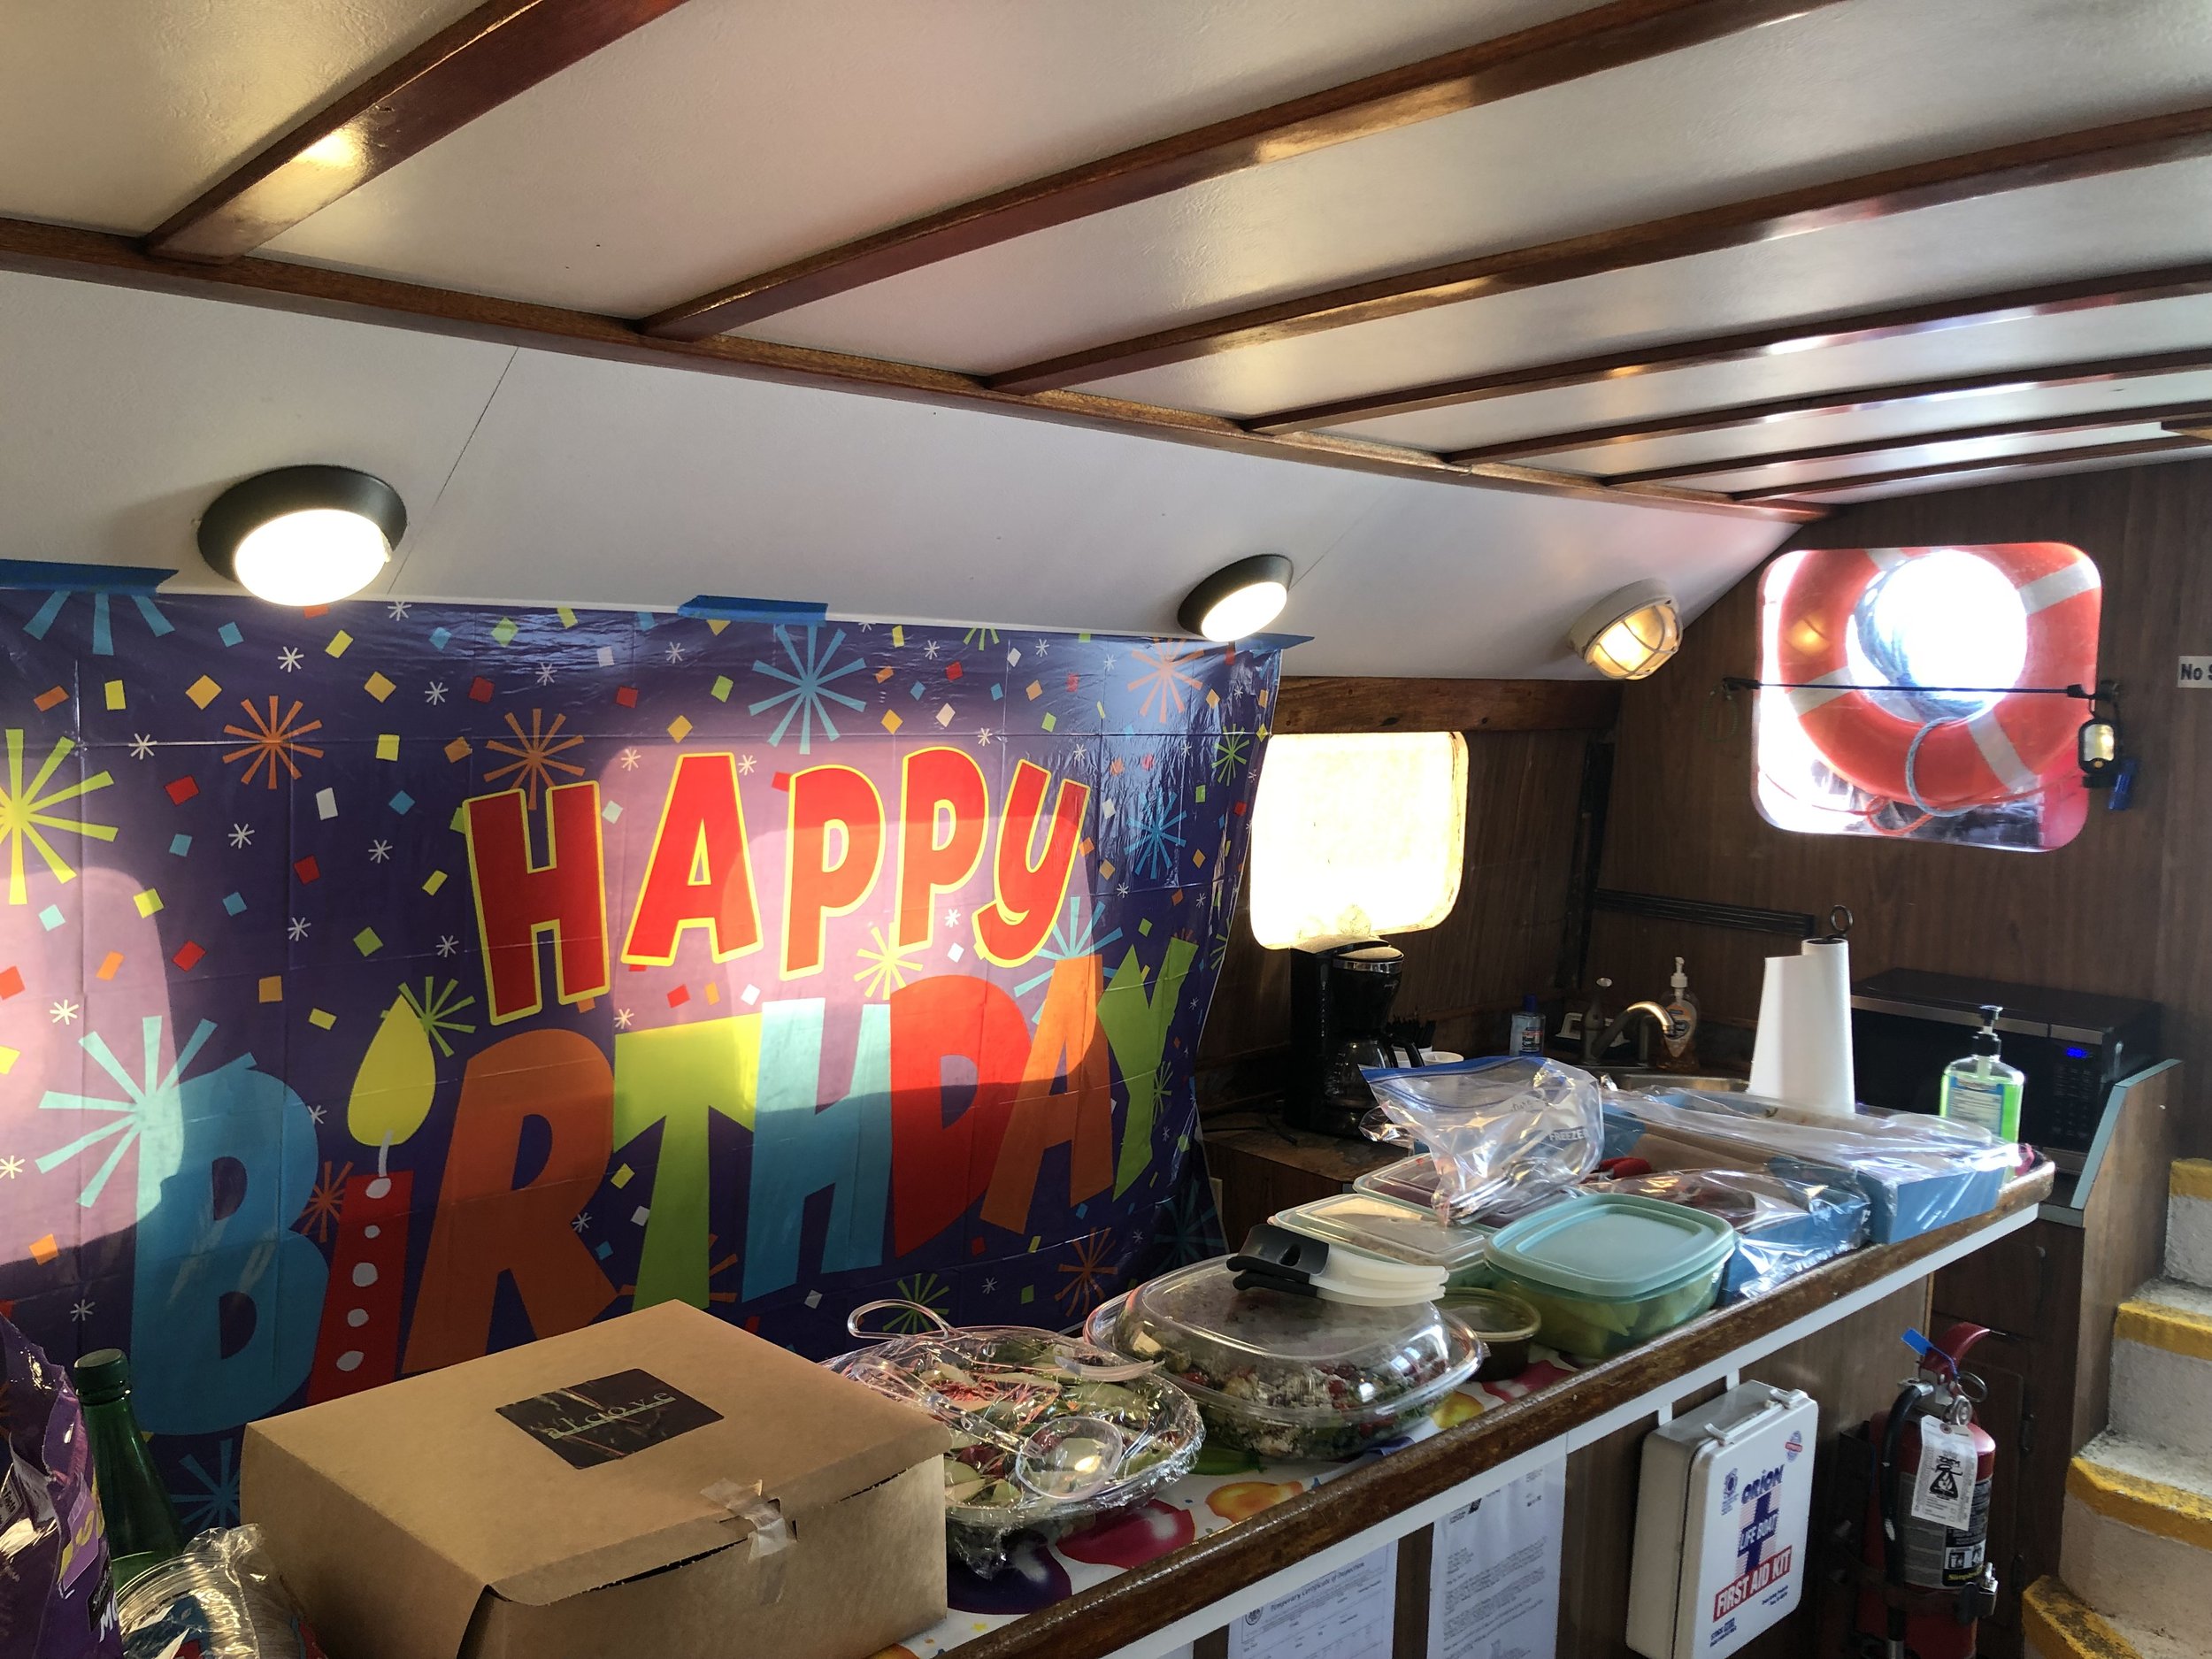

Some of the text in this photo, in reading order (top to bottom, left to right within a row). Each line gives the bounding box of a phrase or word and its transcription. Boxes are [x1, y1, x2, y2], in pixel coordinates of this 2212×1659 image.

[2181, 664, 2203, 680] No
[463, 745, 1091, 1025] HAPPY
[548, 1392, 673, 1440] alcove
[1739, 1525, 1757, 1550] LIFE
[1717, 1575, 1750, 1617] FIRST
[1750, 1562, 1770, 1595] AID
[1771, 1548, 1792, 1580] KIT
